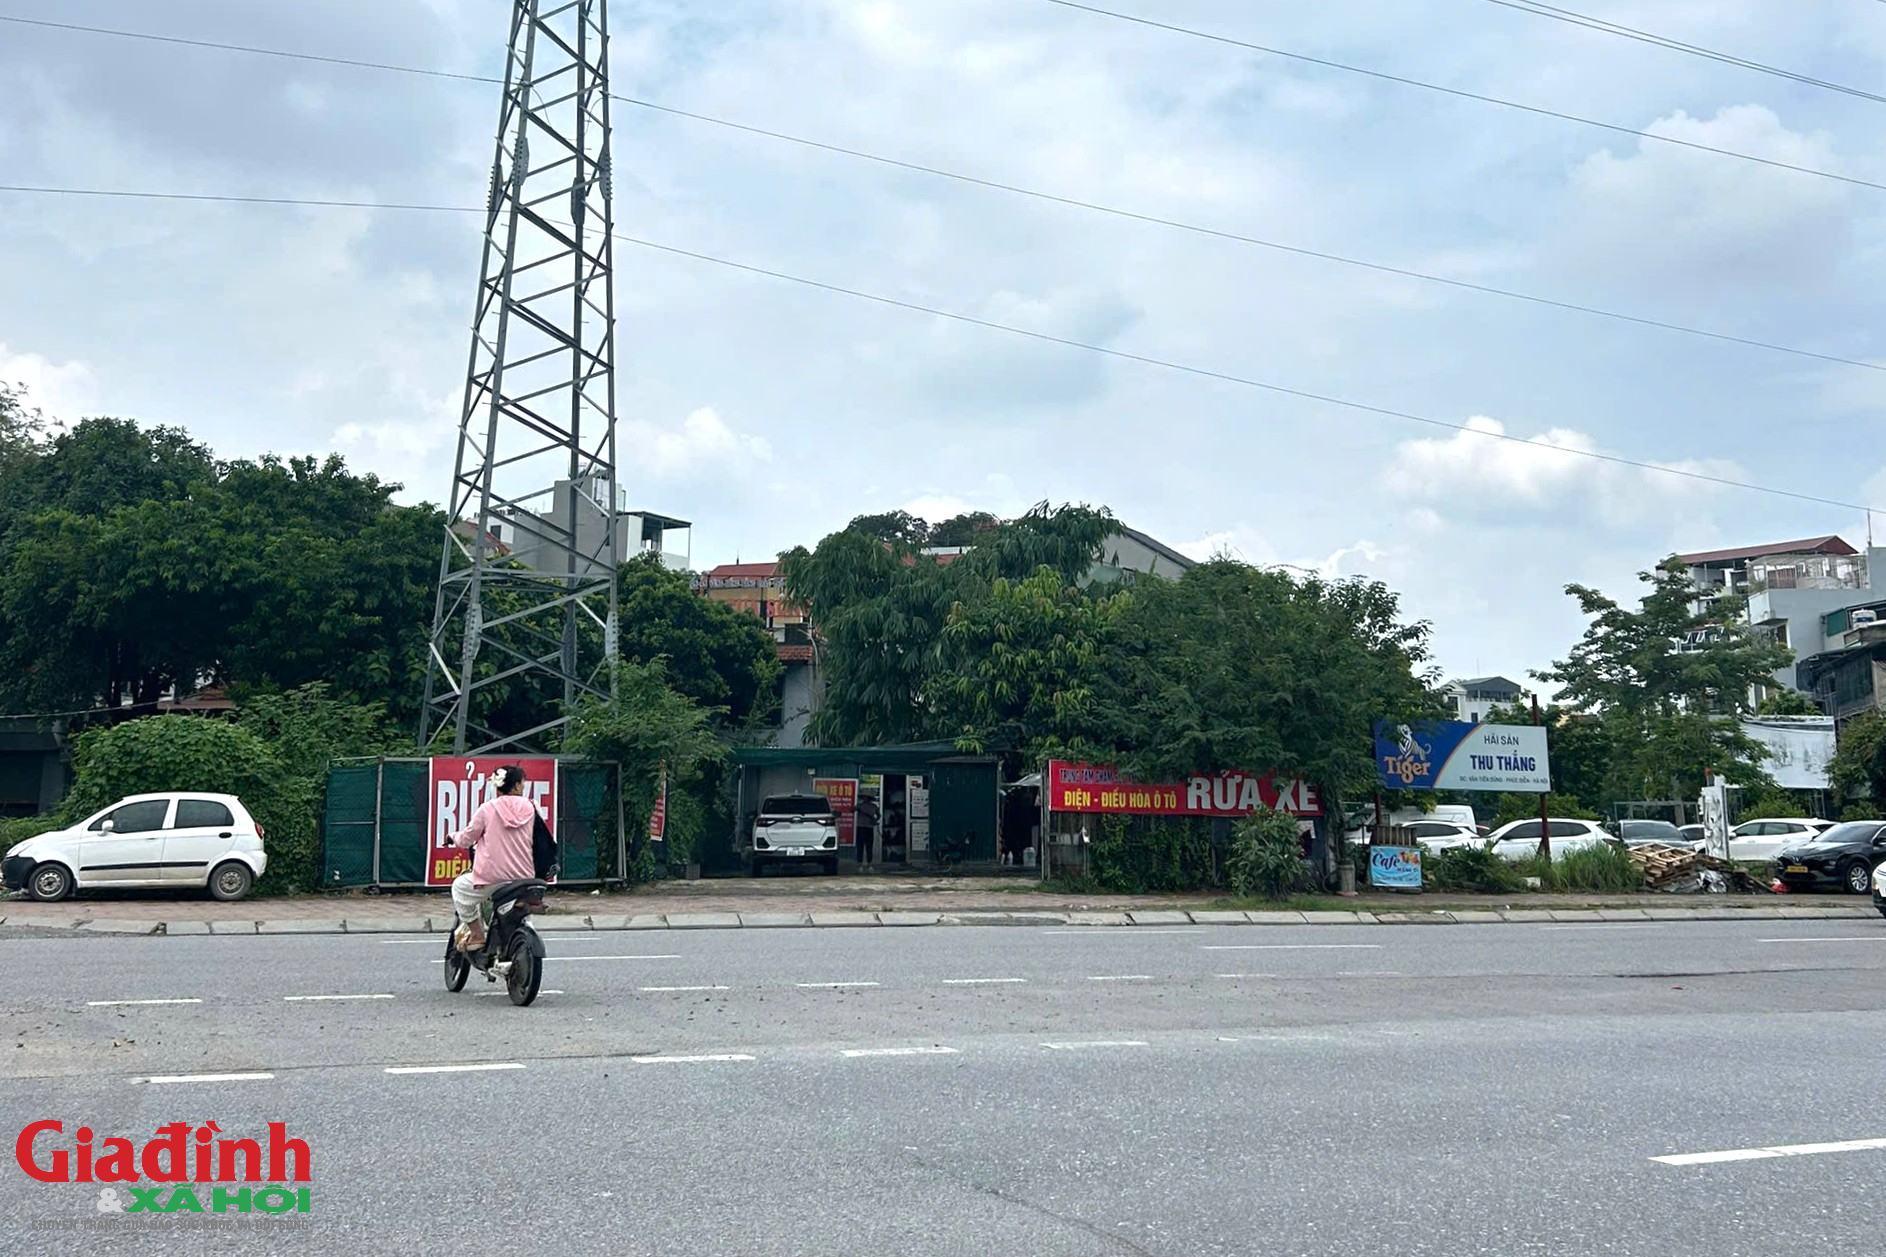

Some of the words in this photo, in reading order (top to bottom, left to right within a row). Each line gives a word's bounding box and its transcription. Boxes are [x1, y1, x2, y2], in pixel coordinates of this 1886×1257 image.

[1484, 733, 1499, 744] HẢI
[1501, 733, 1519, 745] SẢN
[1384, 755, 1431, 783] Tiger
[1470, 755, 1493, 770] THU
[1496, 749, 1536, 771] THẮNG
[1064, 788, 1091, 810] ĐIỆN
[1101, 787, 1126, 808] ĐIỀU
[1129, 789, 1151, 808] HÒA
[1154, 790, 1161, 808] Ô
[1163, 790, 1177, 808] TÔ
[1187, 769, 1261, 811] RỬA
[1274, 779, 1318, 811] XE
